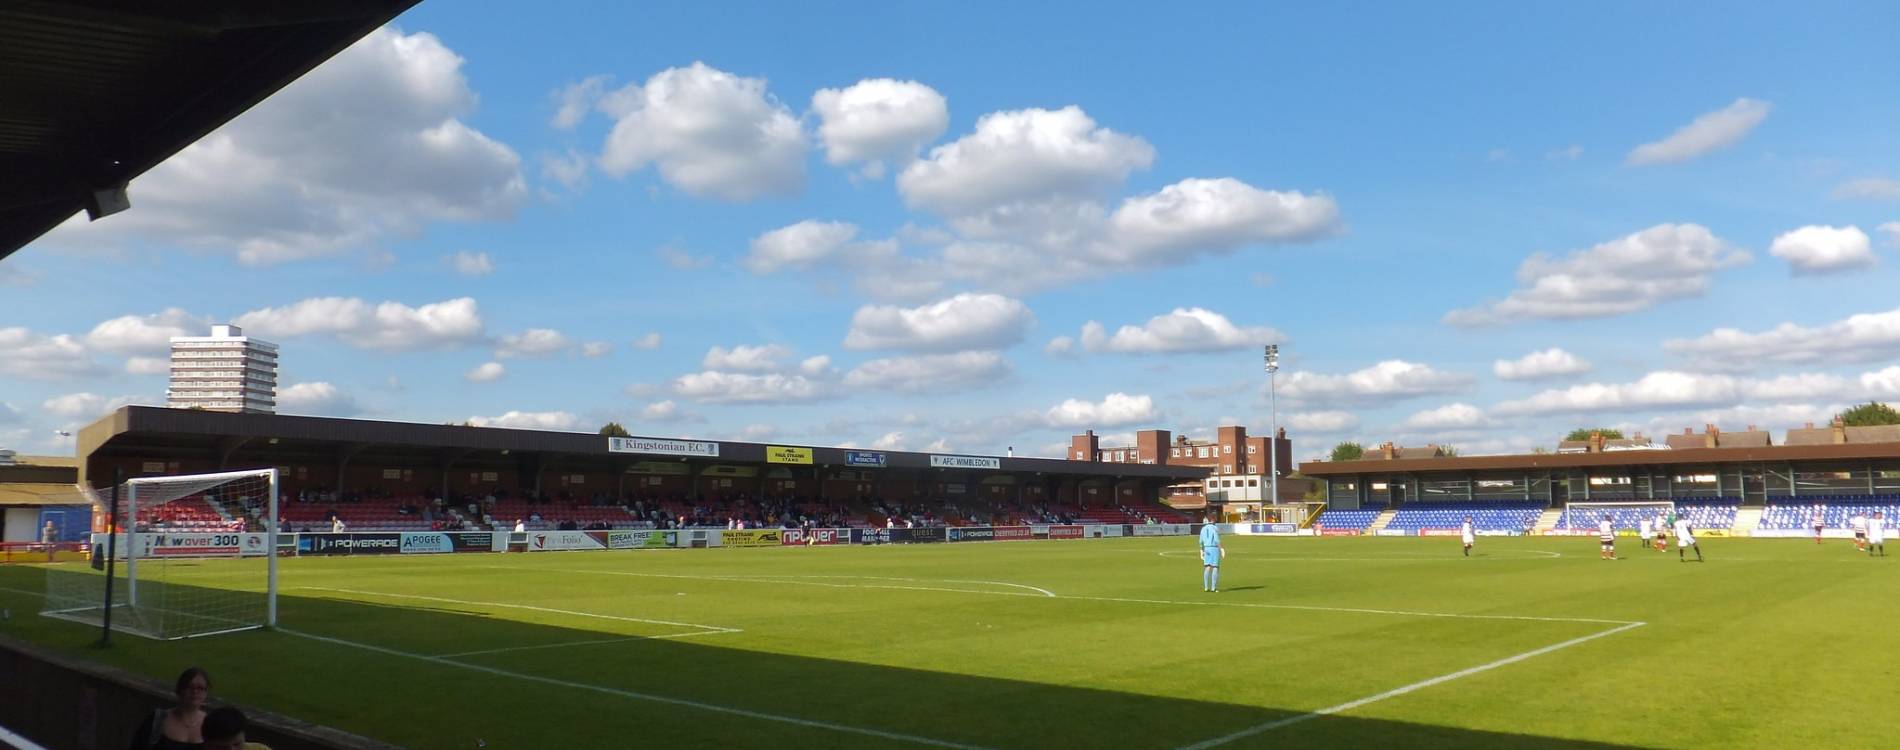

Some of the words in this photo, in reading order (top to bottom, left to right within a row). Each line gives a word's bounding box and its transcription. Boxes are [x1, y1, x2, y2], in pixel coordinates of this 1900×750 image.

[625, 440, 685, 452] Kingstonian
[688, 443, 705, 452] F.C.
[943, 457, 954, 465] AFC
[957, 458, 990, 467] WIMBLEDON
[155, 535, 184, 546] Nw
[185, 537, 212, 546] over
[214, 535, 239, 546] 300
[404, 536, 440, 548] APOGEE
[610, 534, 632, 542] BREAK
[634, 532, 649, 540] FREE
[335, 539, 398, 547] POWERADE
